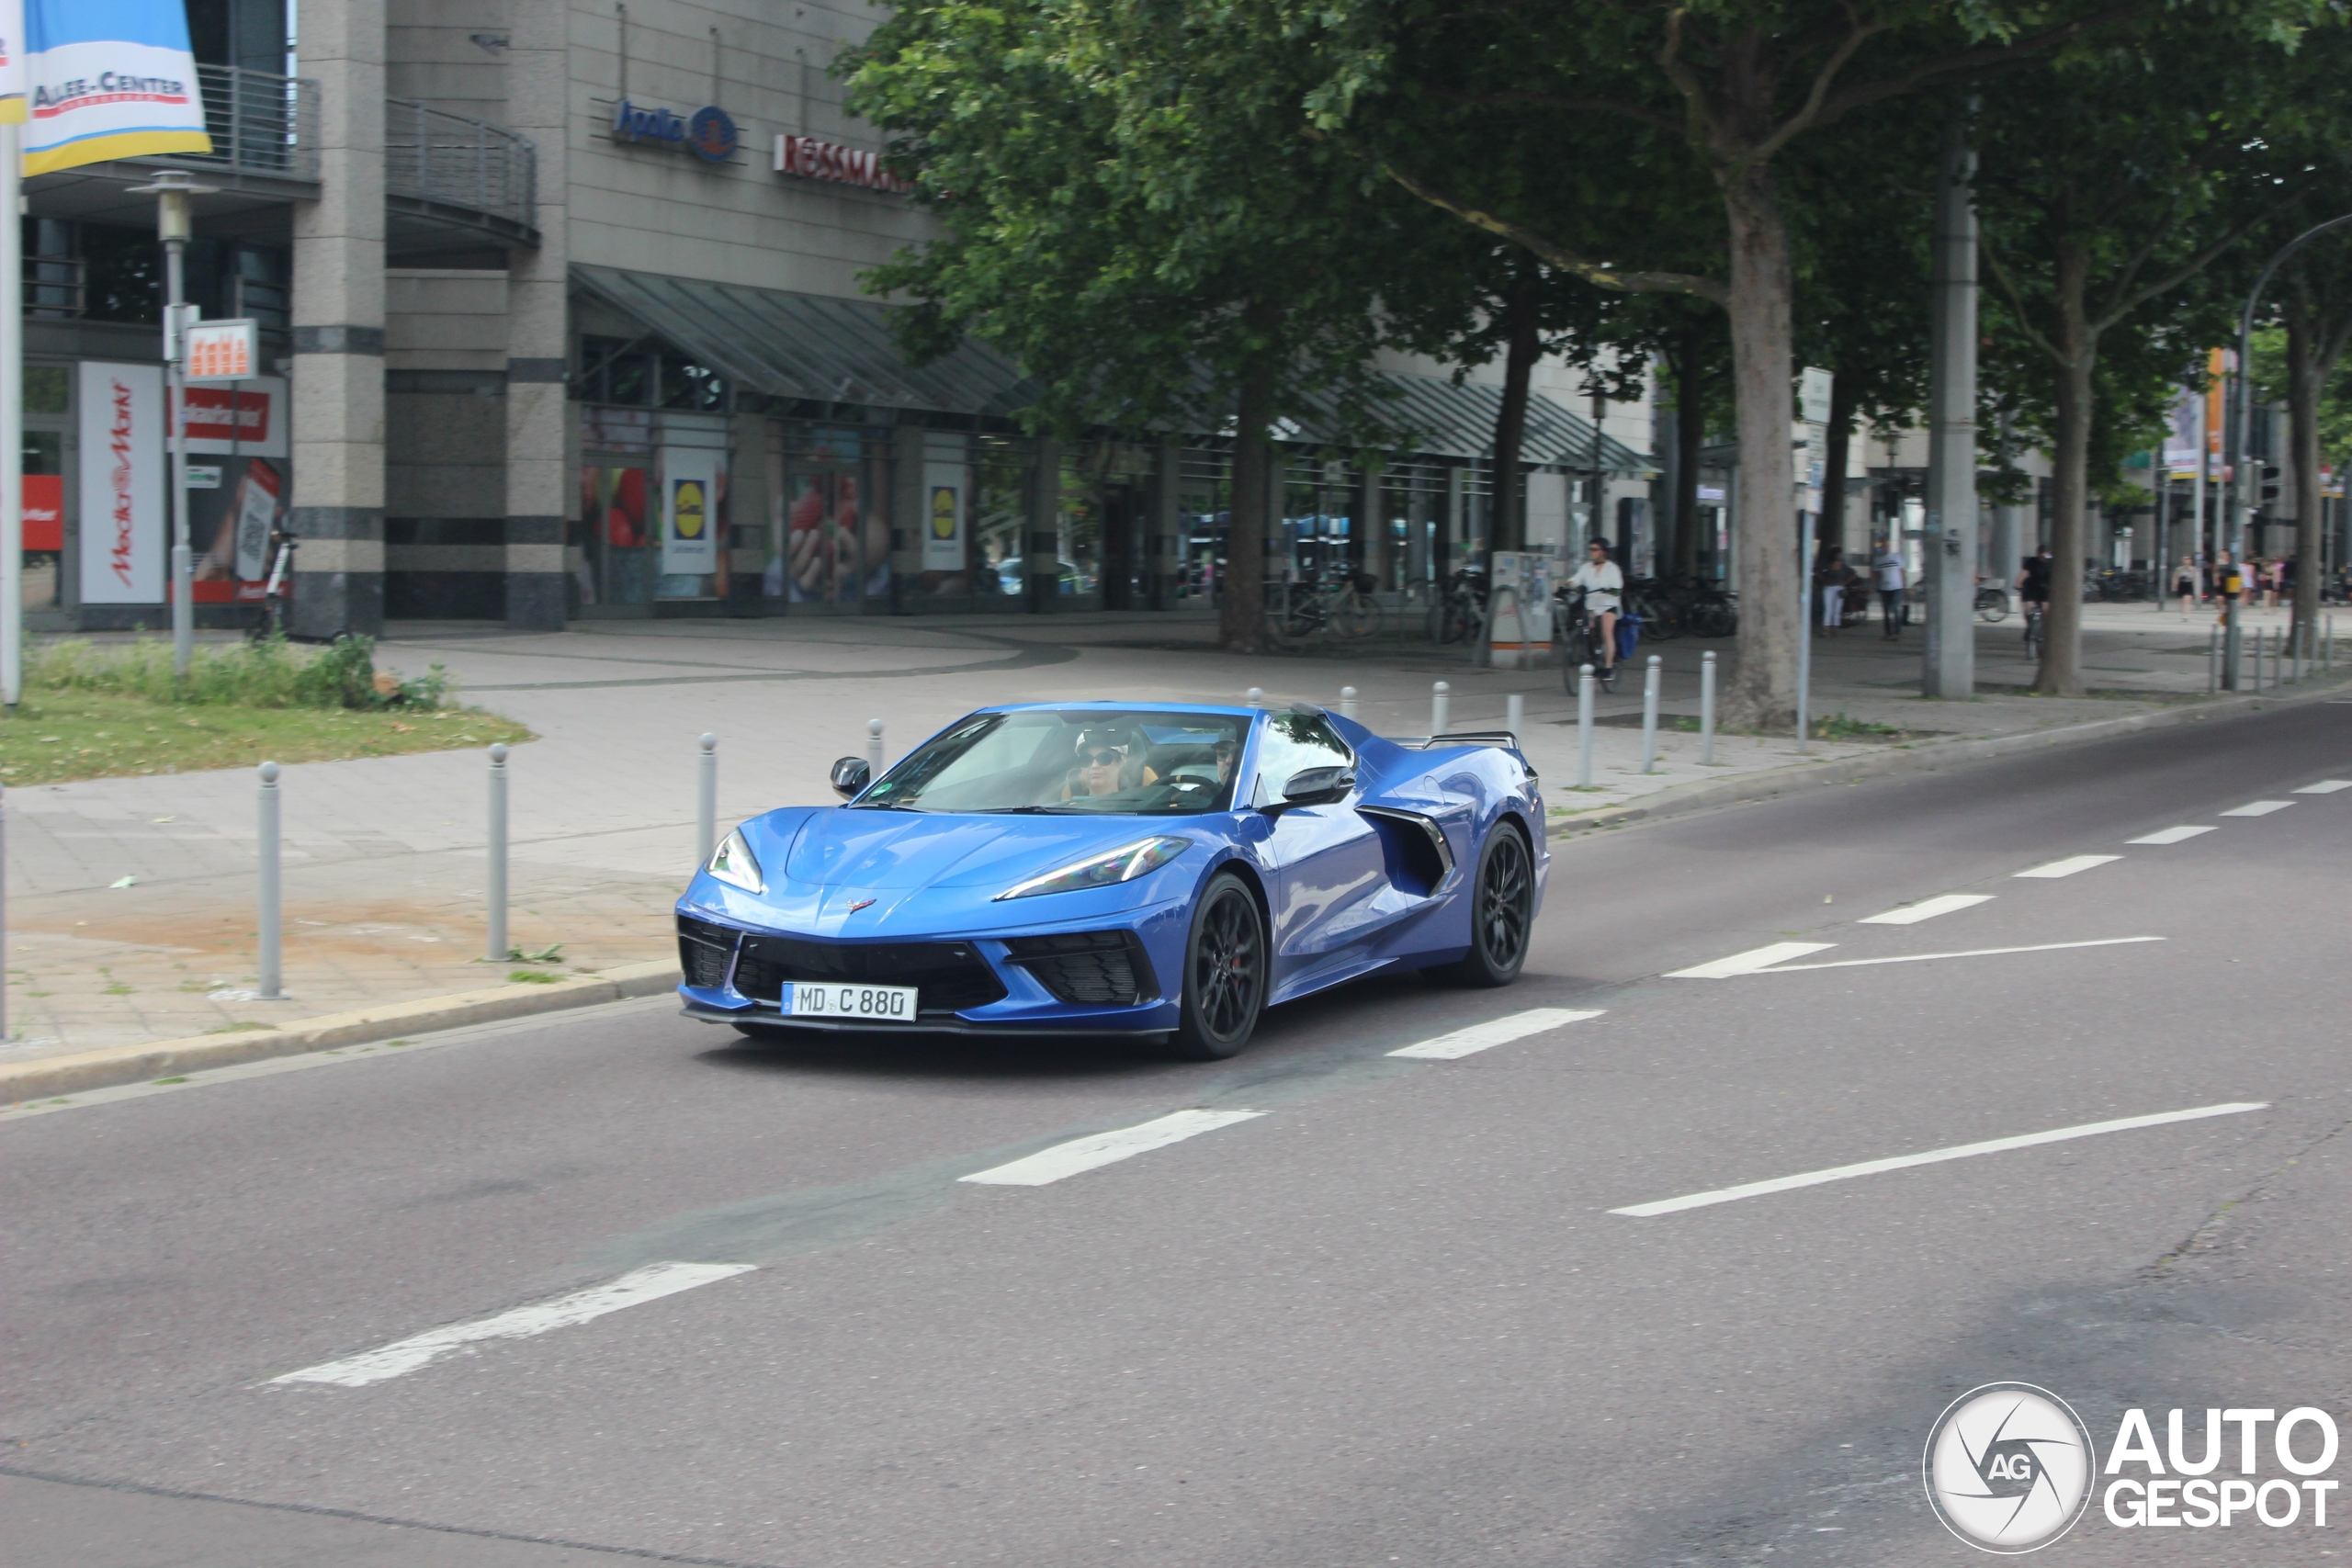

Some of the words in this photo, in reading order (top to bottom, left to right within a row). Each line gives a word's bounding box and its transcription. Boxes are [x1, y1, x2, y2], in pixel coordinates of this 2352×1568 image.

[799, 987, 825, 1011] MD
[840, 988, 853, 1011] C
[860, 989, 904, 1016] 880
